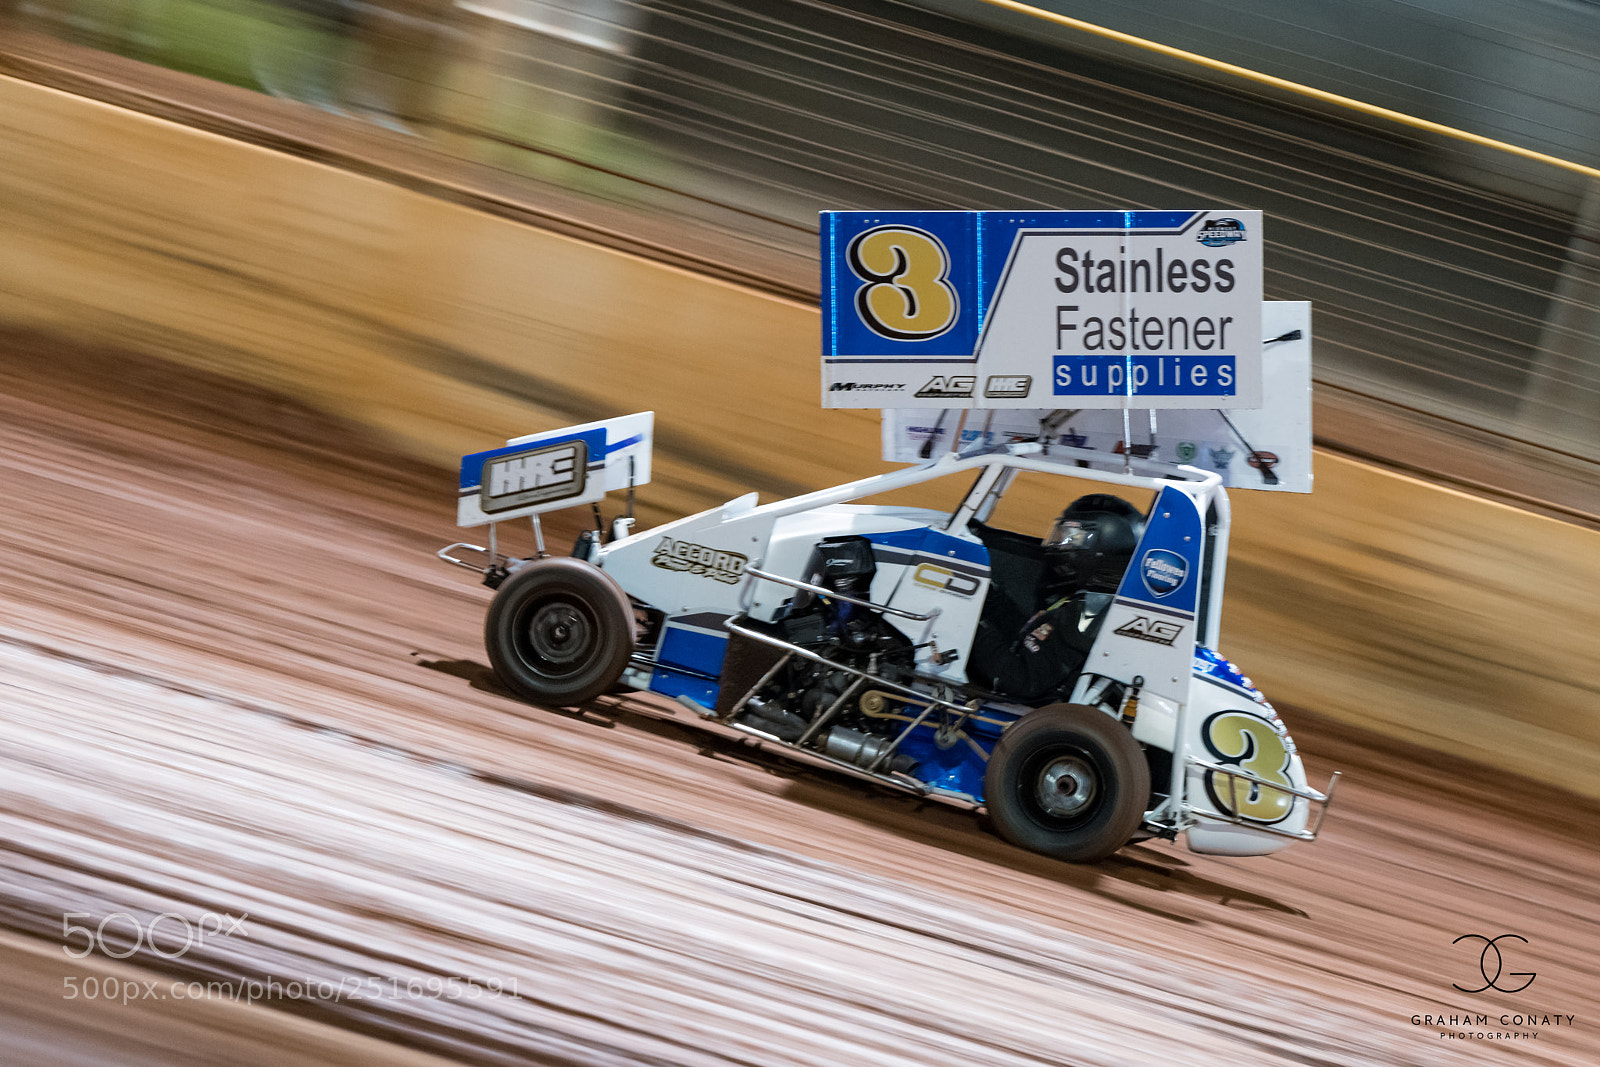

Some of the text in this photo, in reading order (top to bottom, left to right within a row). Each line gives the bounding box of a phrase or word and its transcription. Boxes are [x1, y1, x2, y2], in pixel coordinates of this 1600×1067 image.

[846, 224, 960, 341] 3
[1054, 244, 1236, 293] Stainless
[1056, 305, 1234, 351] Fastener
[917, 376, 977, 393] AG
[1055, 357, 1233, 394] supplies
[653, 536, 747, 576] ACCORD
[1116, 615, 1184, 641] AG
[1202, 709, 1295, 825] 3
